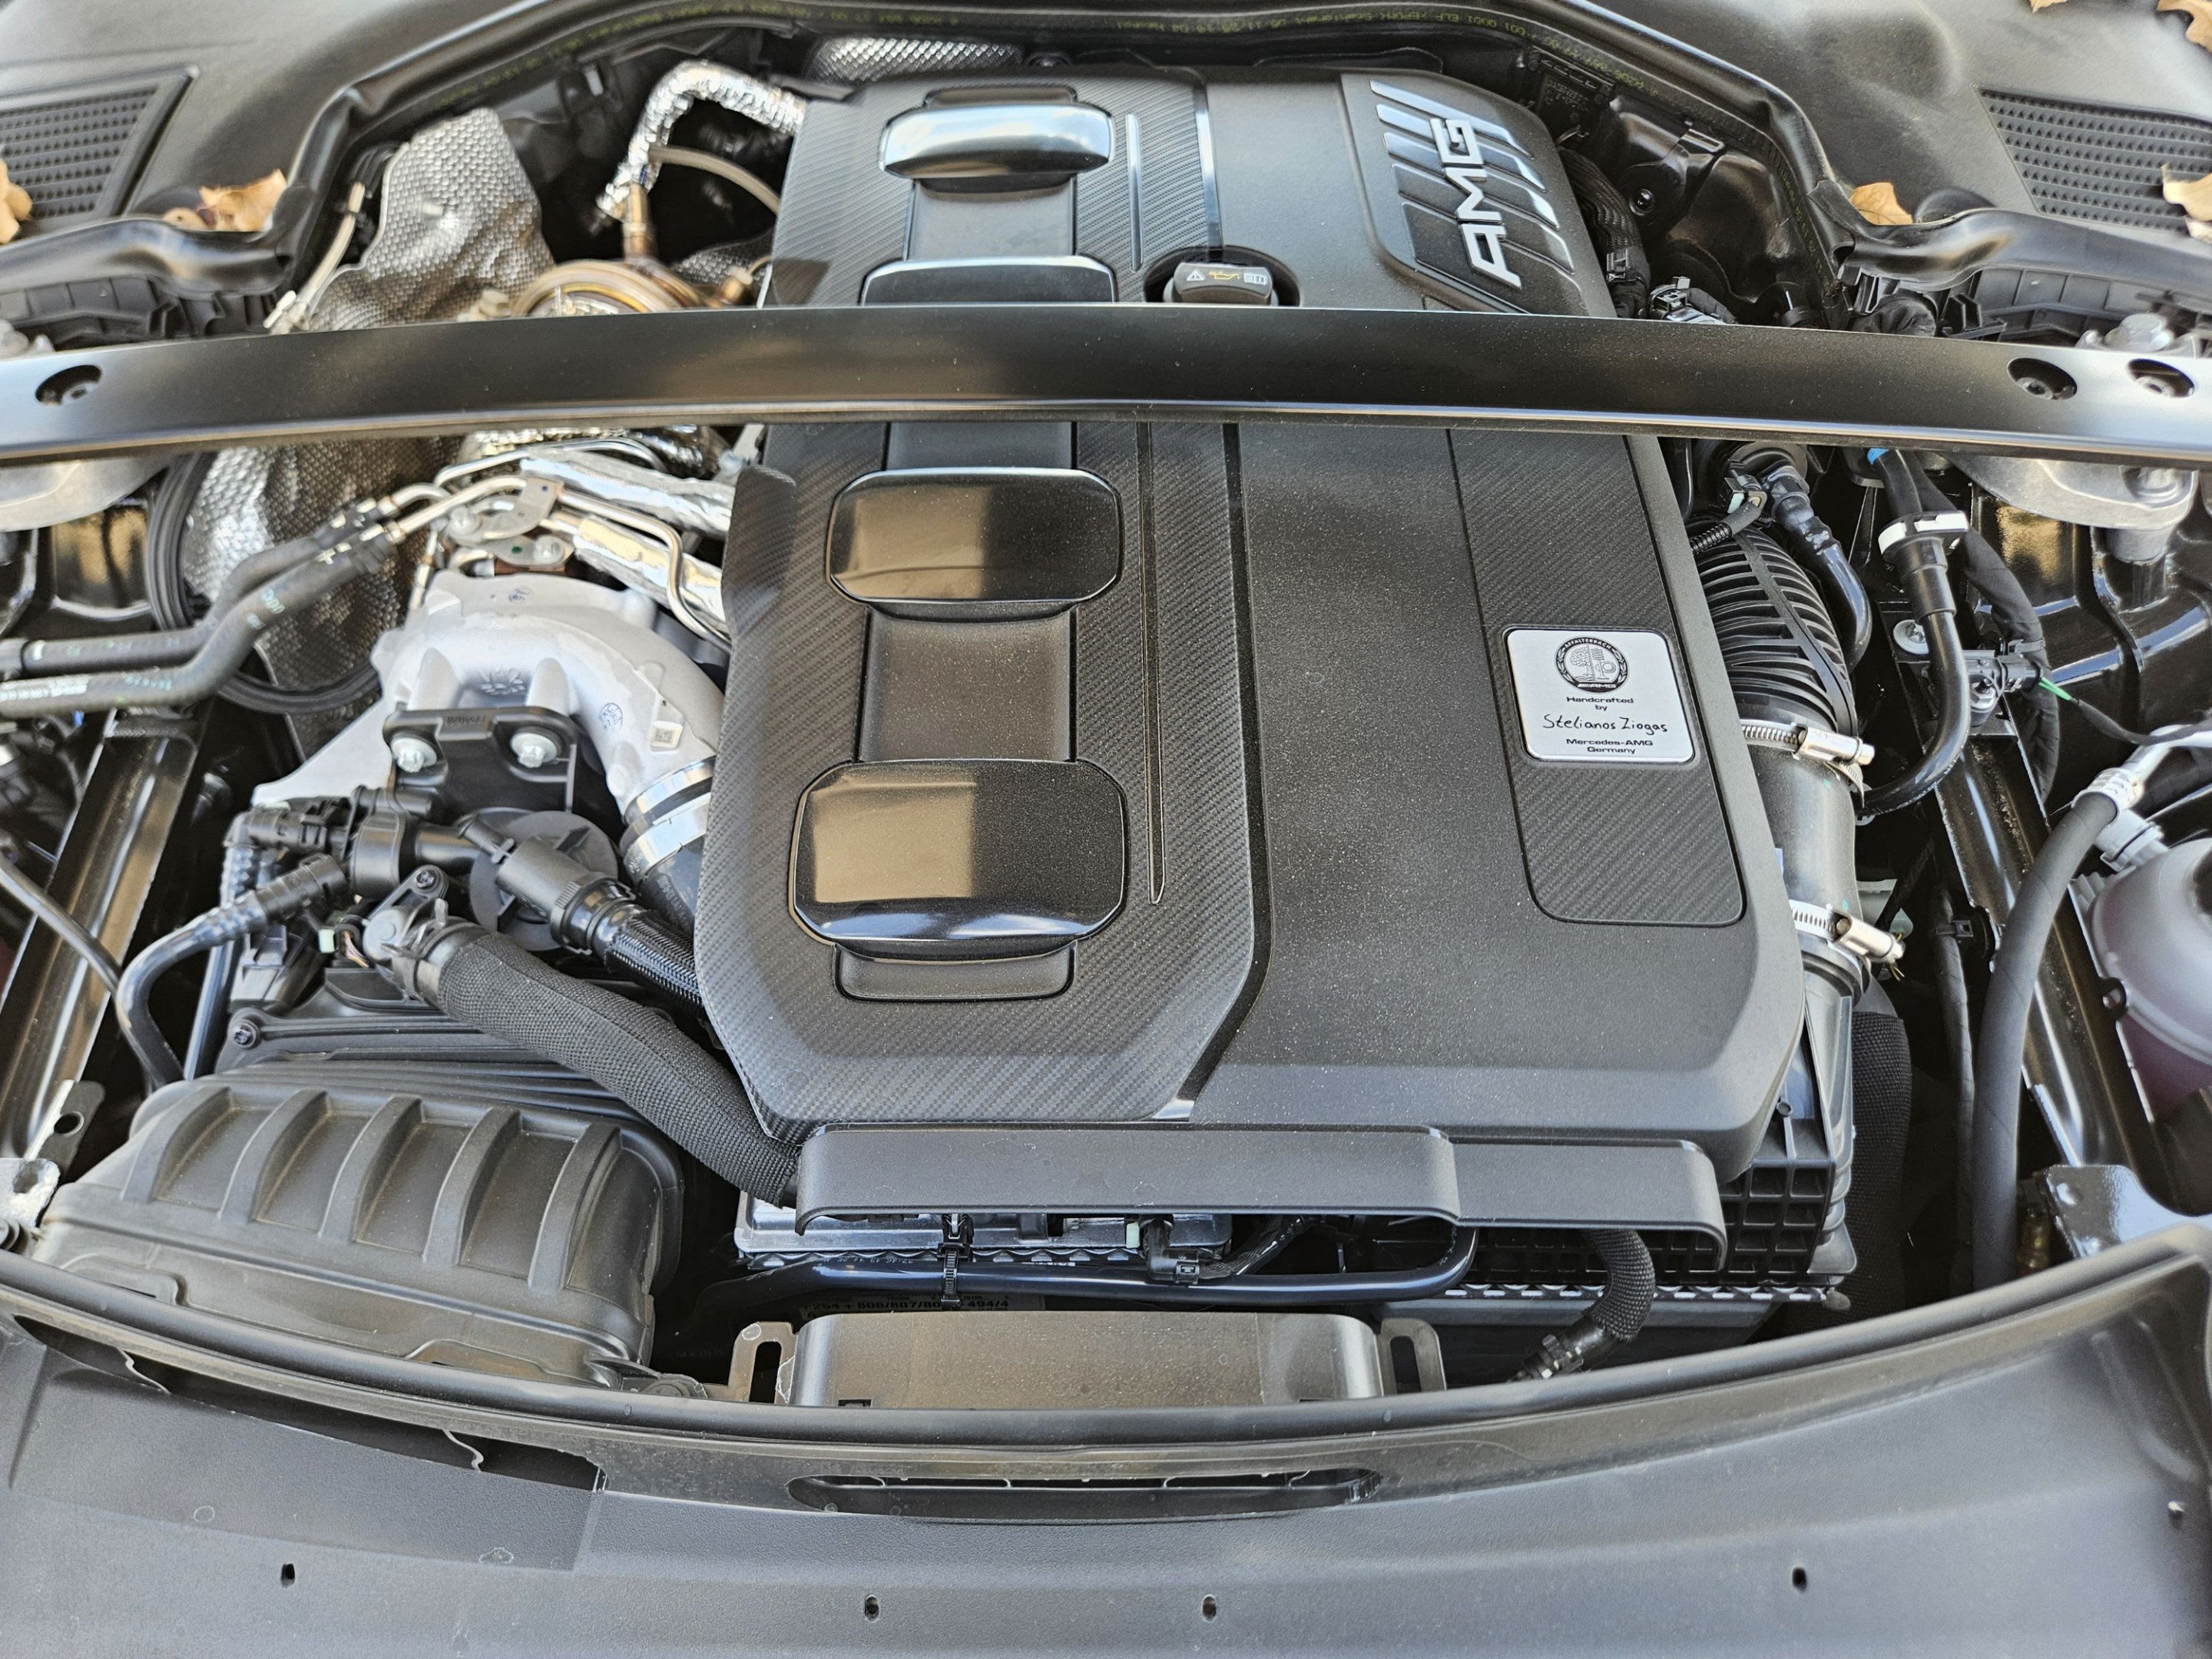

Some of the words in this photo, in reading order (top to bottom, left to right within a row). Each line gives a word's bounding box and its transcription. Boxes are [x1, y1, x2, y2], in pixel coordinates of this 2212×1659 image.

[1437, 12, 1459, 22] ELF
[1429, 118, 1522, 290] AMG
[1542, 714, 1616, 730] Stelianos
[1619, 717, 1668, 736] Ziogas
[858, 1300, 942, 1310] 806/807/80
